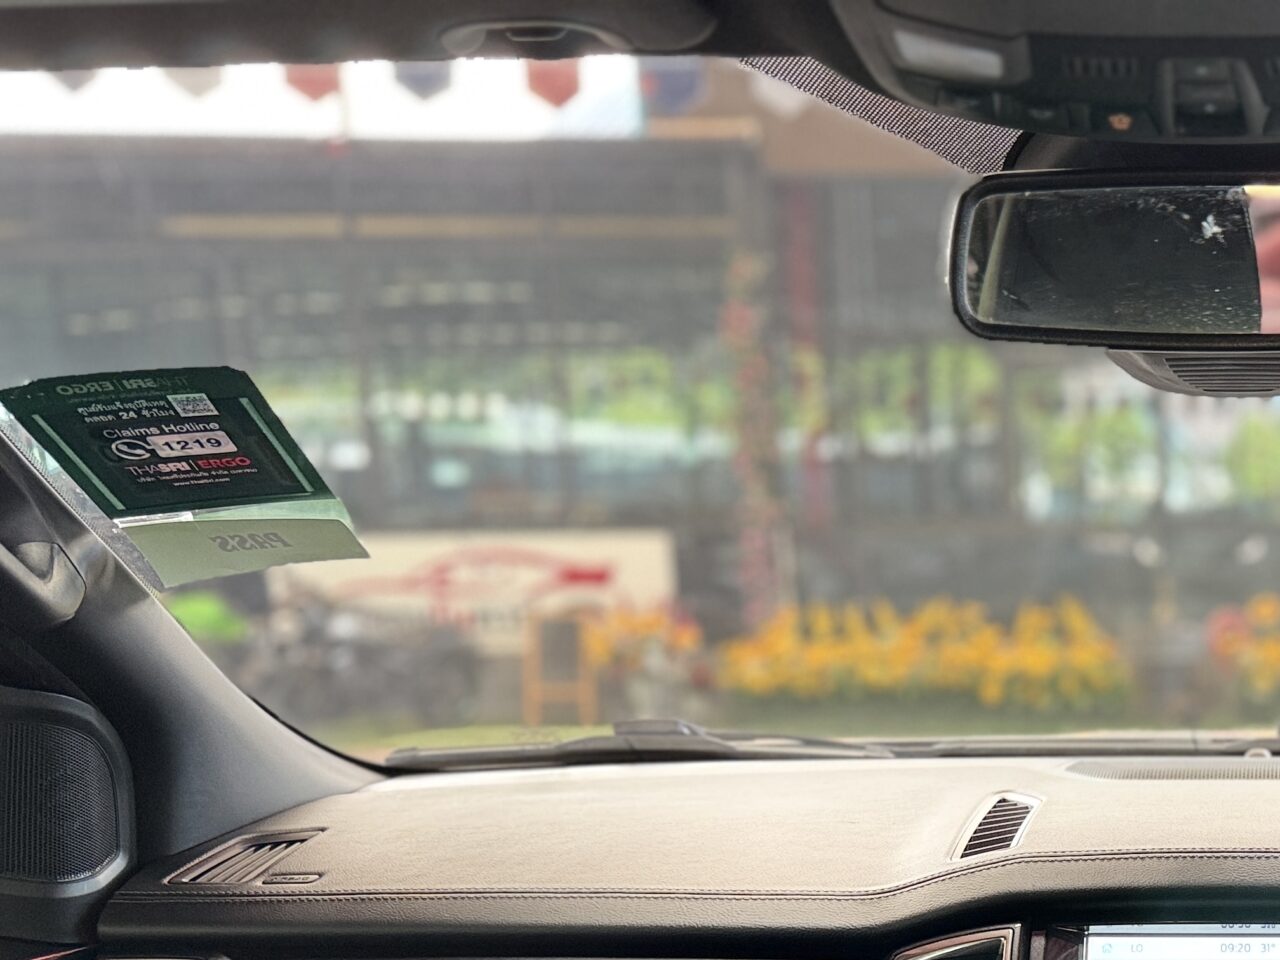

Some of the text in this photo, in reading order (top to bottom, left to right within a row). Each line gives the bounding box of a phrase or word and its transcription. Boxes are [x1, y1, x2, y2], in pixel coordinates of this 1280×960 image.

[118, 410, 138, 420] 24
[103, 421, 220, 438] Claims Hotline
[162, 437, 222, 451] 1219
[196, 456, 251, 469] ERGO
[1130, 944, 1144, 953] LO
[1220, 943, 1251, 953] 09:20
[1260, 943, 1276, 953] 31°
